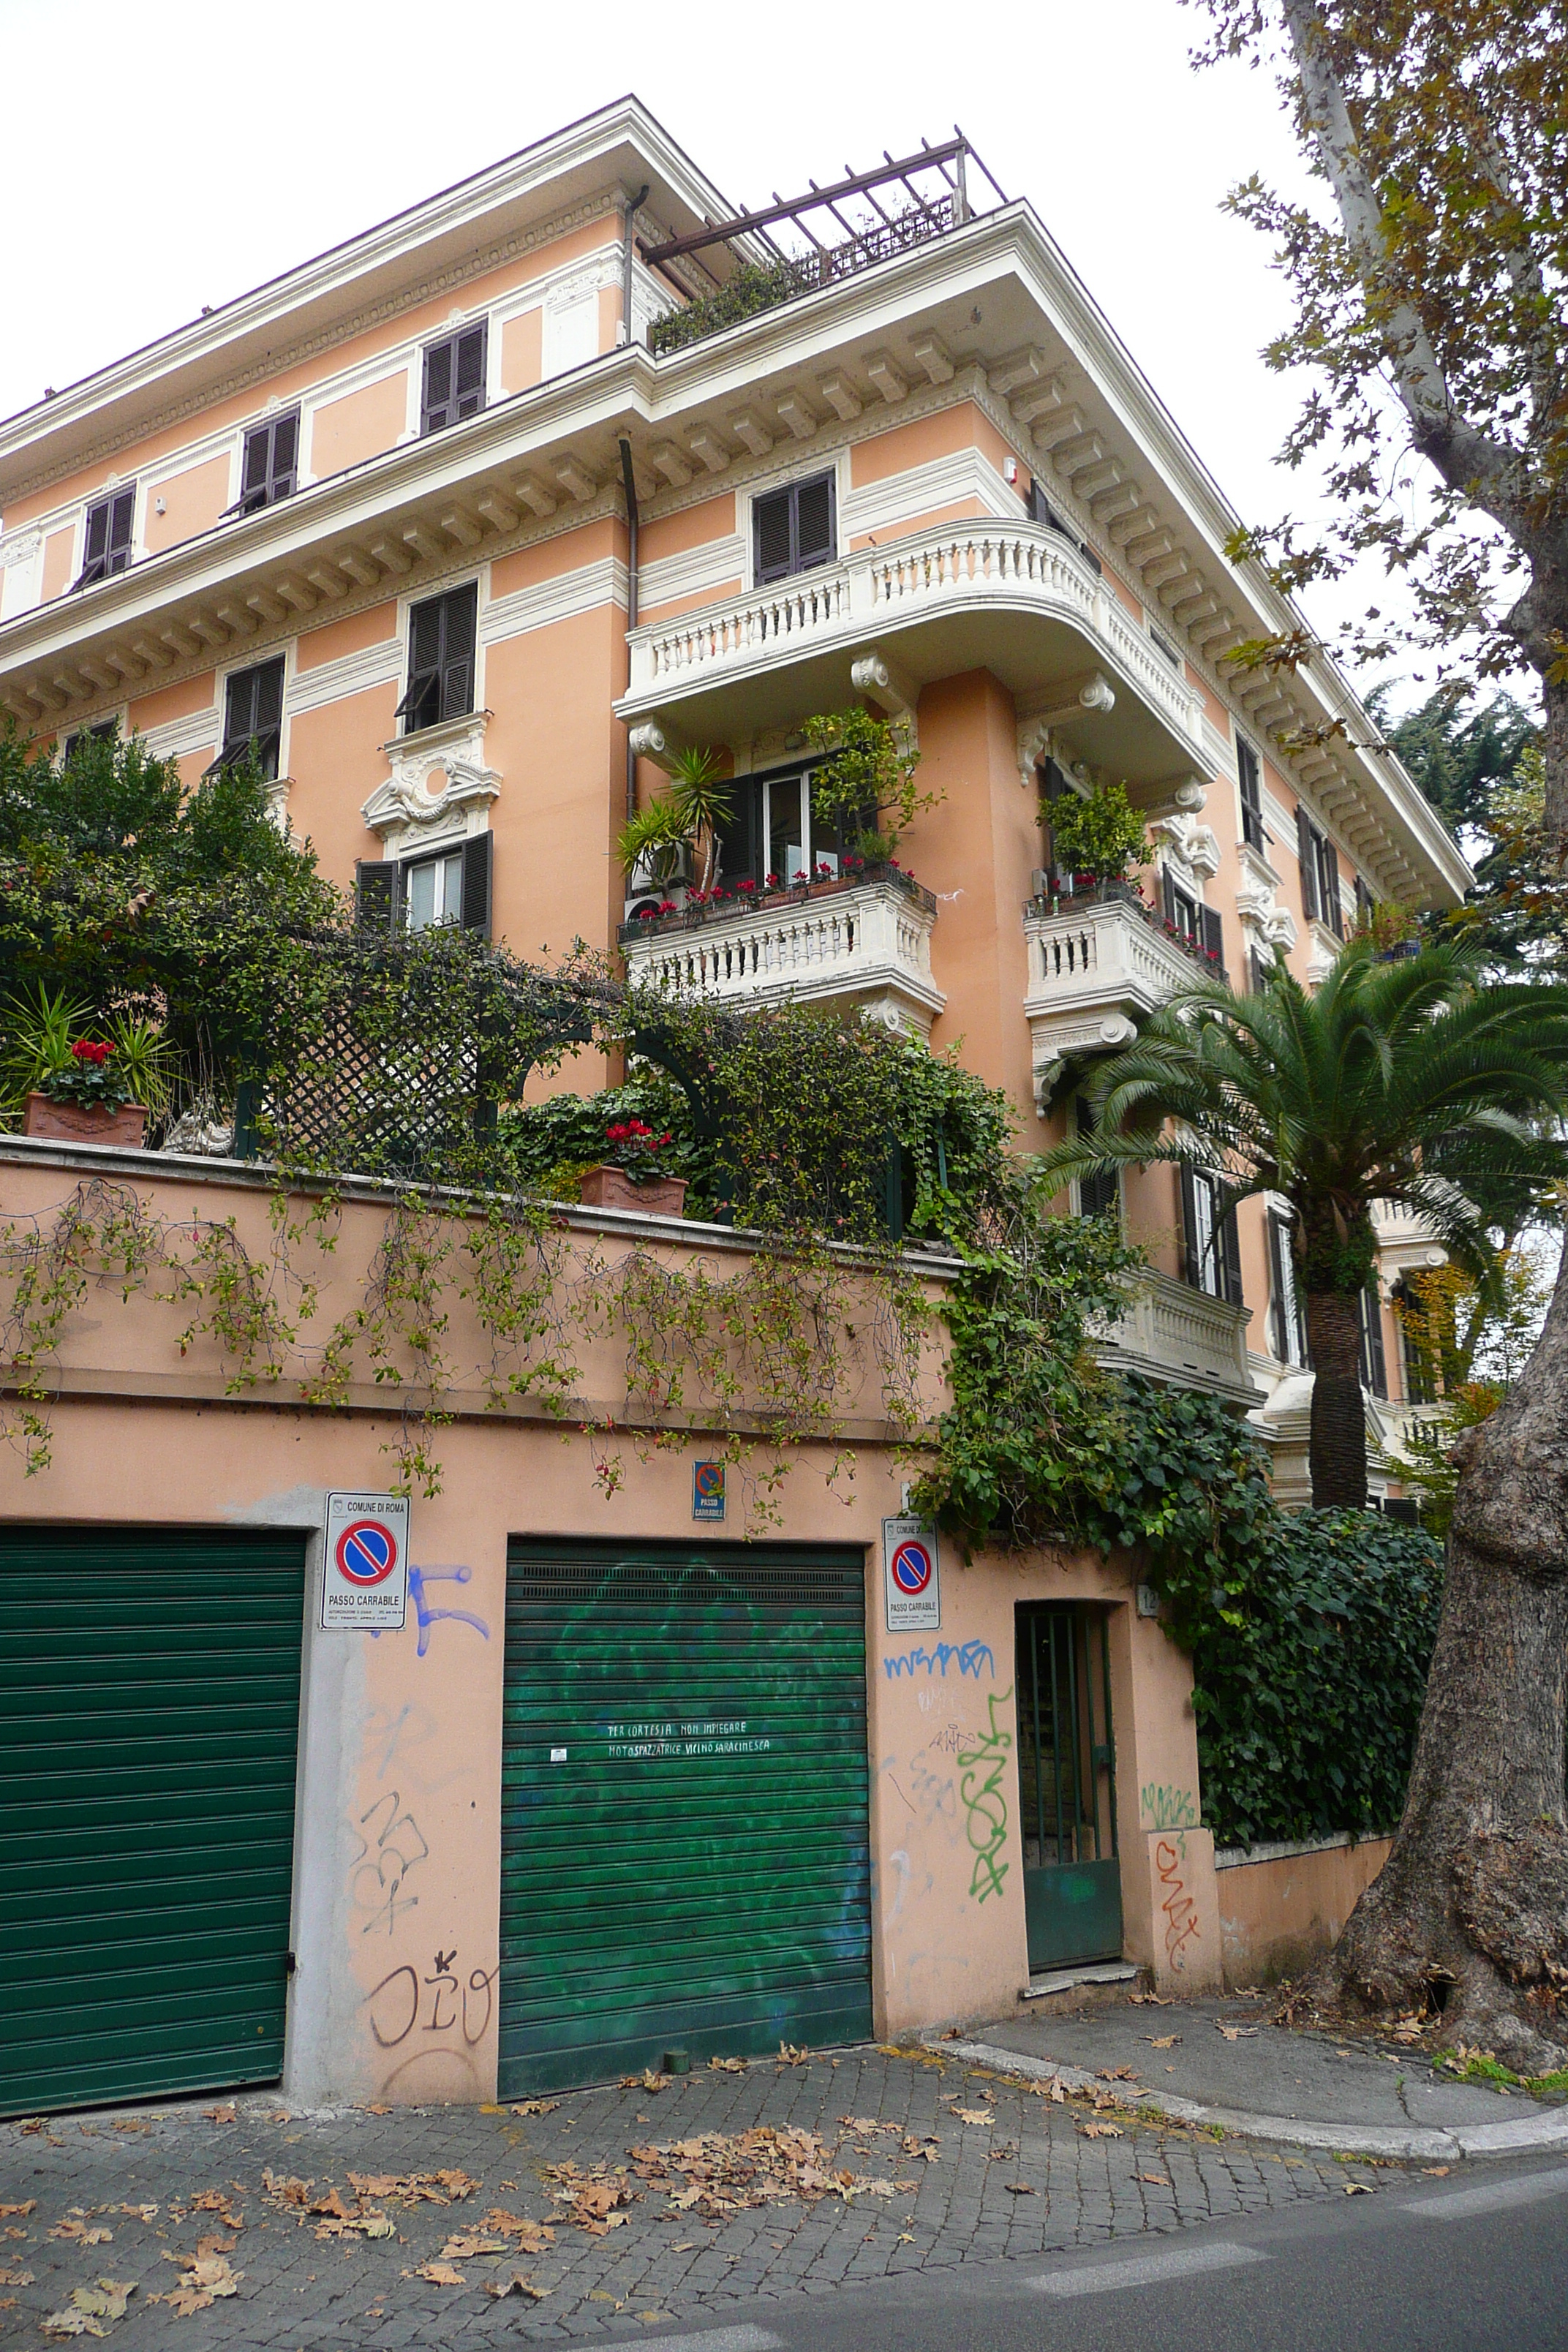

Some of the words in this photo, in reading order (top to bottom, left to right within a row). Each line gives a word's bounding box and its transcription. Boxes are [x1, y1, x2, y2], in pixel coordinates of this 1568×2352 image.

[347, 1501, 376, 1512] COMUNE
[377, 1503, 384, 1512] DI
[385, 1504, 404, 1513] ROMA
[701, 1499, 717, 1507] PASSO
[897, 1526, 916, 1534] COMUNE
[329, 1596, 355, 1605] PASSO
[357, 1596, 399, 1605] CARRABILE
[1143, 1591, 1156, 1609] 12
[890, 1603, 907, 1612] PASSO
[908, 1602, 936, 1611] CARRABILE
[608, 1725, 625, 1736] PER
[628, 1724, 671, 1737] CORTESIA
[681, 1725, 698, 1735] NON
[704, 1722, 746, 1735] IMPIEGARE
[685, 1743, 712, 1754] VICINO
[715, 1740, 770, 1754] SARACINESCA
